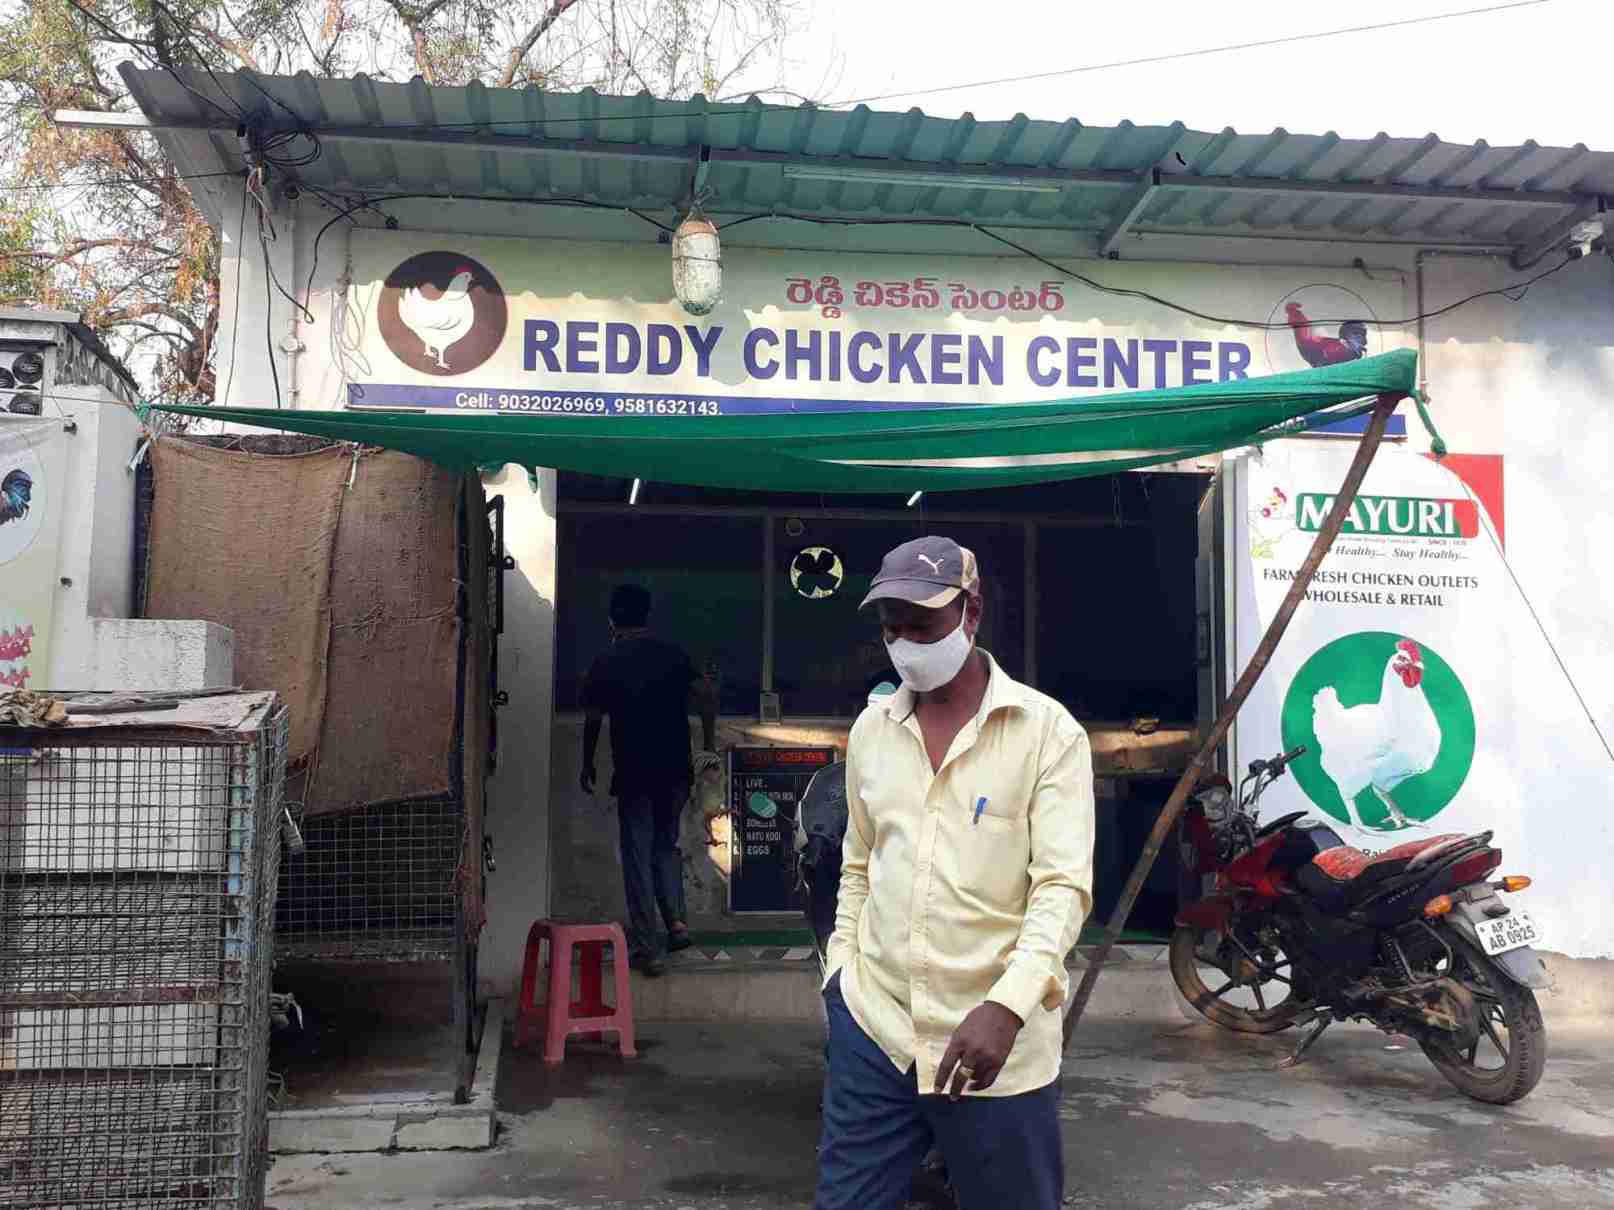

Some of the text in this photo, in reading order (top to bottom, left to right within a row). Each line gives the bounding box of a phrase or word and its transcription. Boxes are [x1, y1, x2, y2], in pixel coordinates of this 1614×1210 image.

[785, 275, 1065, 319] రెడ్డి చికెన్ సెంటర్
[523, 319, 1252, 390] REDDY CHICKEN CENTER
[455, 392, 723, 416] Cell: 9032026969, 9581632143.
[1392, 547, 1416, 560] Stay
[1311, 570, 1347, 584] RESH
[1352, 571, 1414, 586] CHICKEN
[1418, 574, 1479, 589] OUTLETS
[1386, 592, 1396, 605] &
[1400, 593, 1444, 606] RETAIL
[1490, 925, 1536, 950] AB 0925
[1491, 921, 1504, 934] AP
